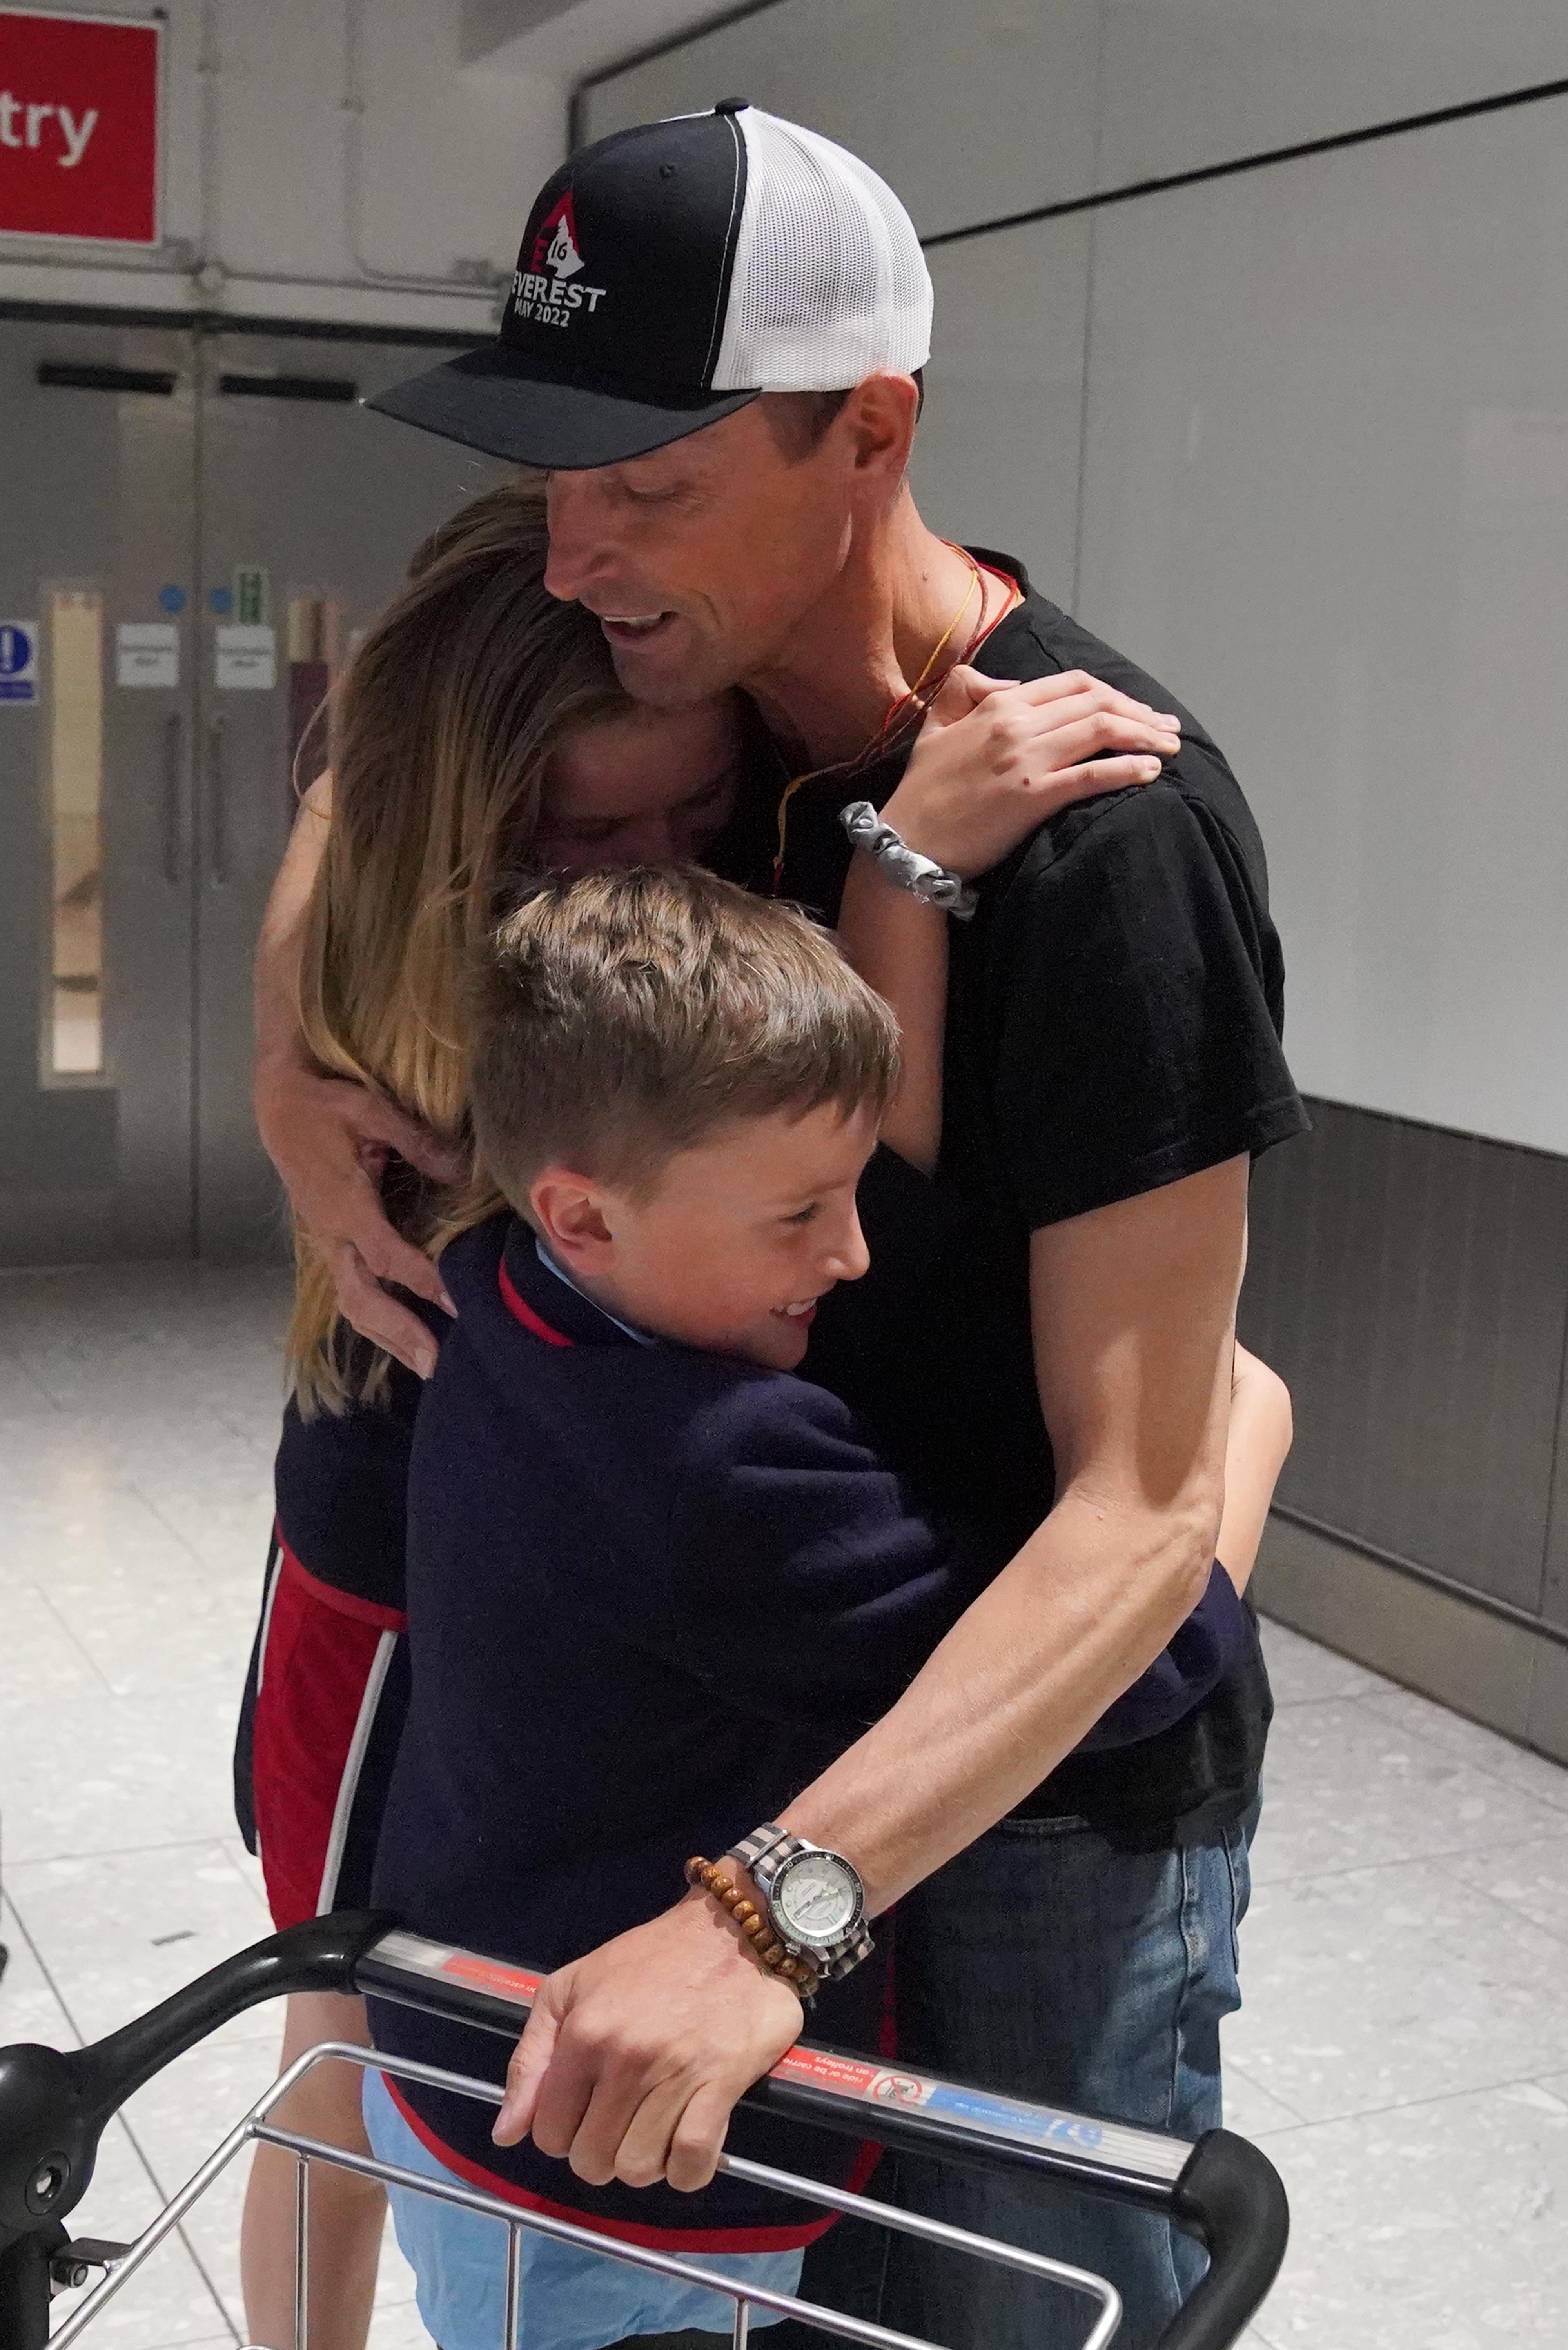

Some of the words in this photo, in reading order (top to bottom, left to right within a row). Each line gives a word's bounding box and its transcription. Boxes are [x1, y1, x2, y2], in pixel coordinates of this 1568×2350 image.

[551, 240, 567, 260] 16
[512, 269, 606, 312] EVEREST
[514, 298, 534, 318] MAY
[534, 304, 570, 327] 2022
[813, 2065, 828, 2075] be
[815, 2057, 854, 2071] trolleys
